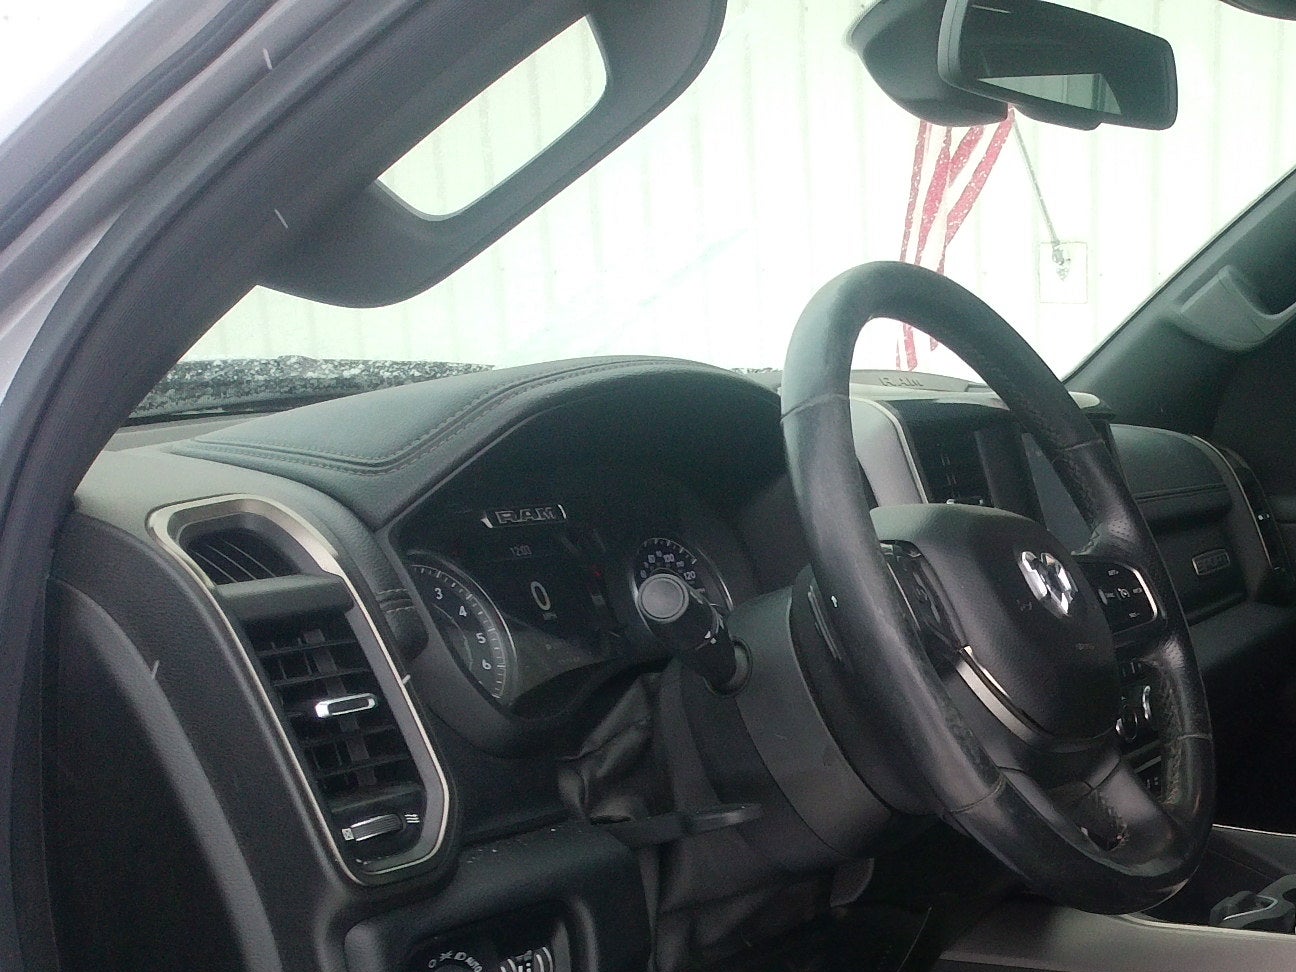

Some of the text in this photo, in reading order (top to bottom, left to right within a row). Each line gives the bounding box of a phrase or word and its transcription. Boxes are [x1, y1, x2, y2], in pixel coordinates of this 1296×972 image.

[495, 507, 557, 524] RAM
[434, 587, 443, 600] 3
[530, 581, 552, 611] 0
[459, 605, 468, 617] 4
[475, 632, 486, 644] 5
[482, 659, 492, 670] 6
